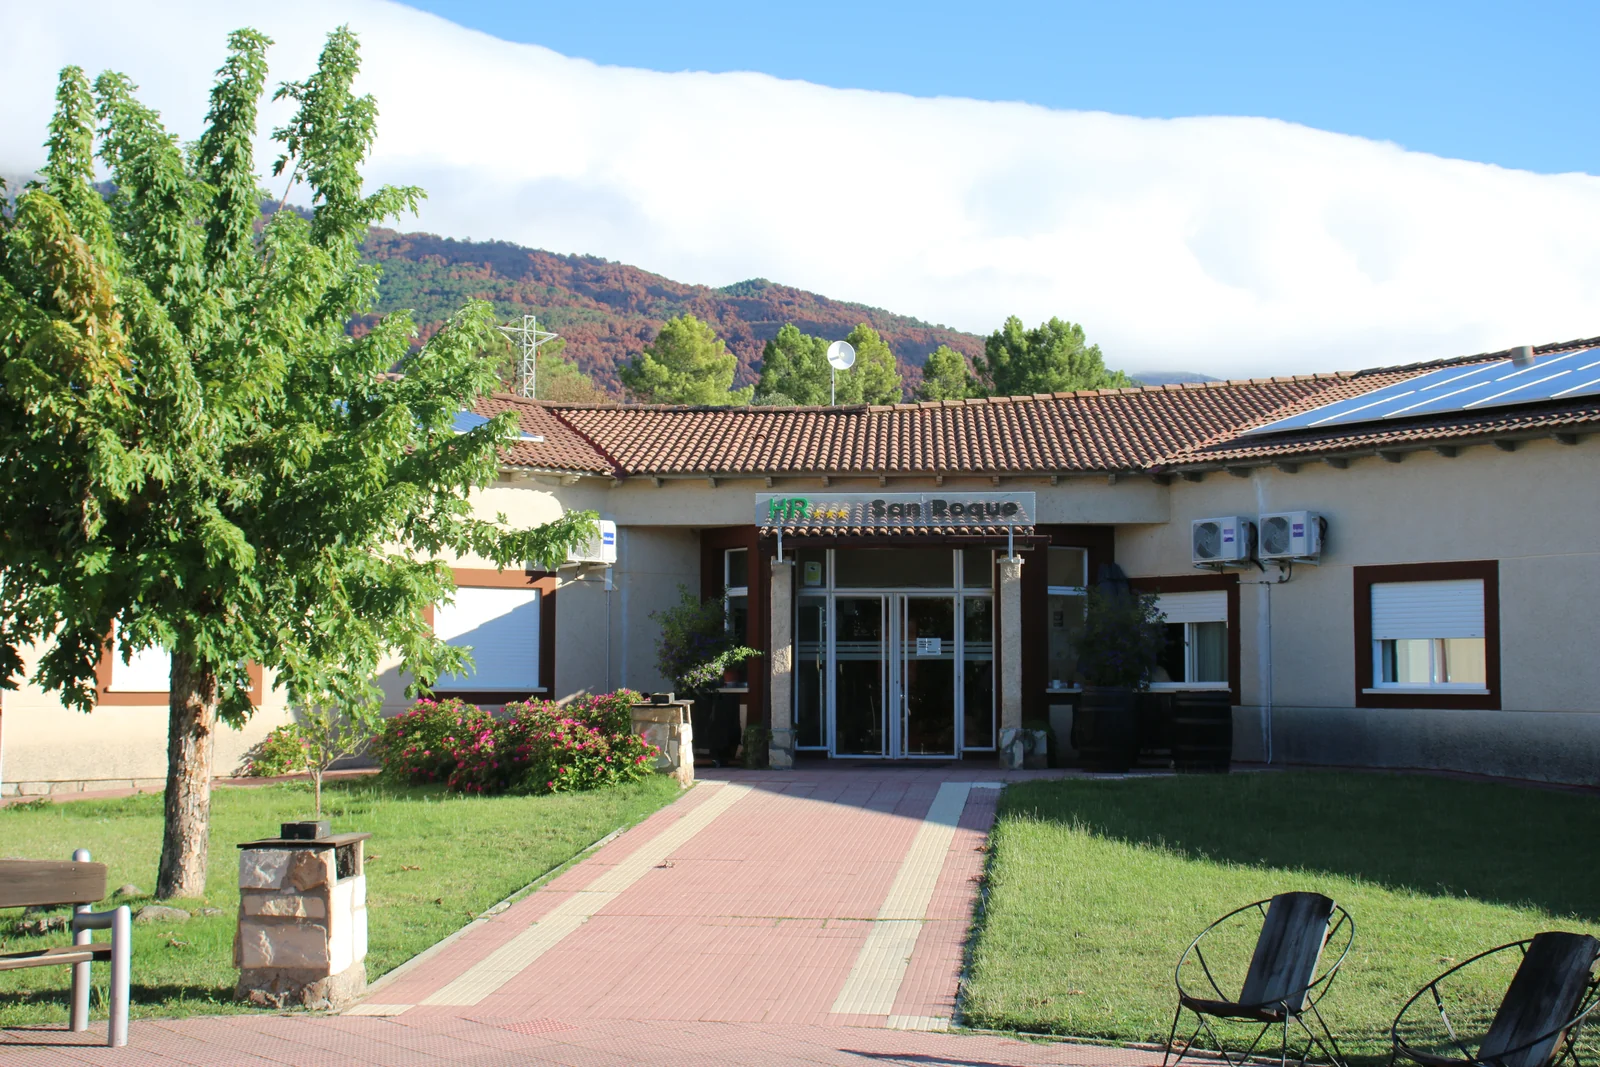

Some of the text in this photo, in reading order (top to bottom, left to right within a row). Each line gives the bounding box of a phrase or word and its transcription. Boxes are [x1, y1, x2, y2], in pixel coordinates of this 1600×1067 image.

[769, 498, 1018, 520] HR San Roque
